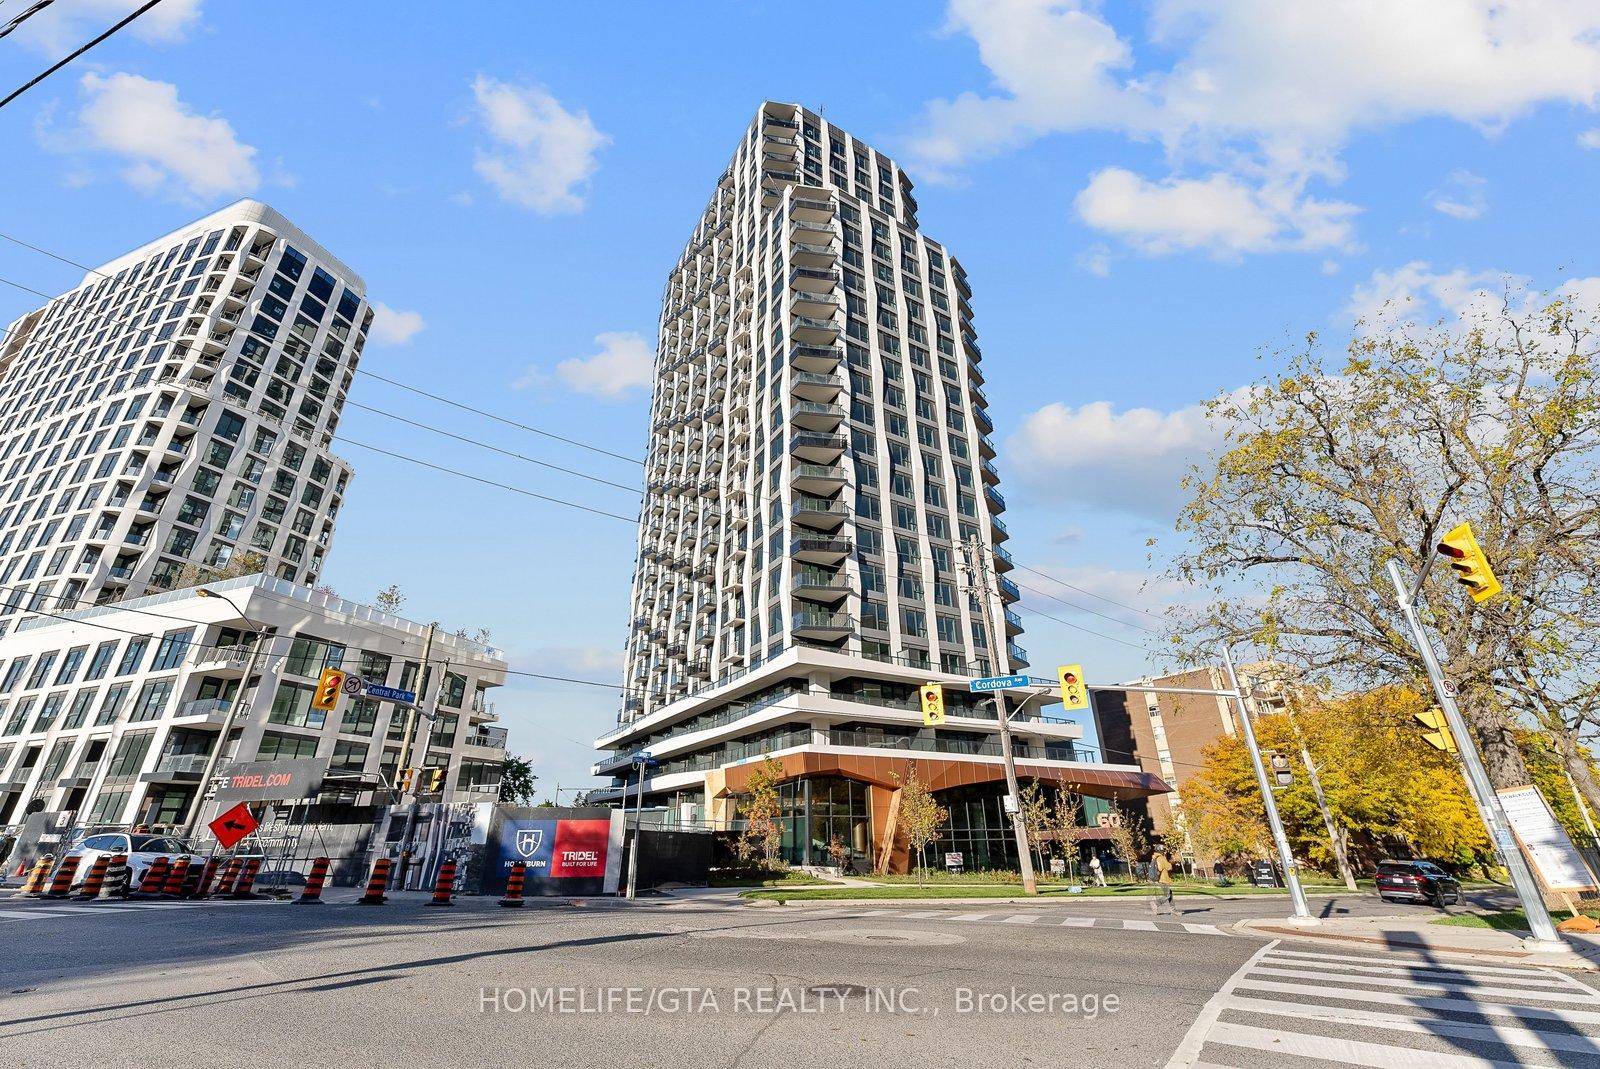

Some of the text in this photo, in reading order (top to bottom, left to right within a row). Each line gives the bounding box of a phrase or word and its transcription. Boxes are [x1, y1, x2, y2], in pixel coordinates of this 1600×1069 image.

[975, 680, 1012, 689] Cordova
[368, 685, 390, 697] Central
[391, 691, 405, 700] Park
[231, 773, 292, 789] TRIDEL.COM
[1097, 813, 1121, 828] 60
[562, 851, 598, 861] TRIDEL
[504, 860, 547, 868] HOBURN
